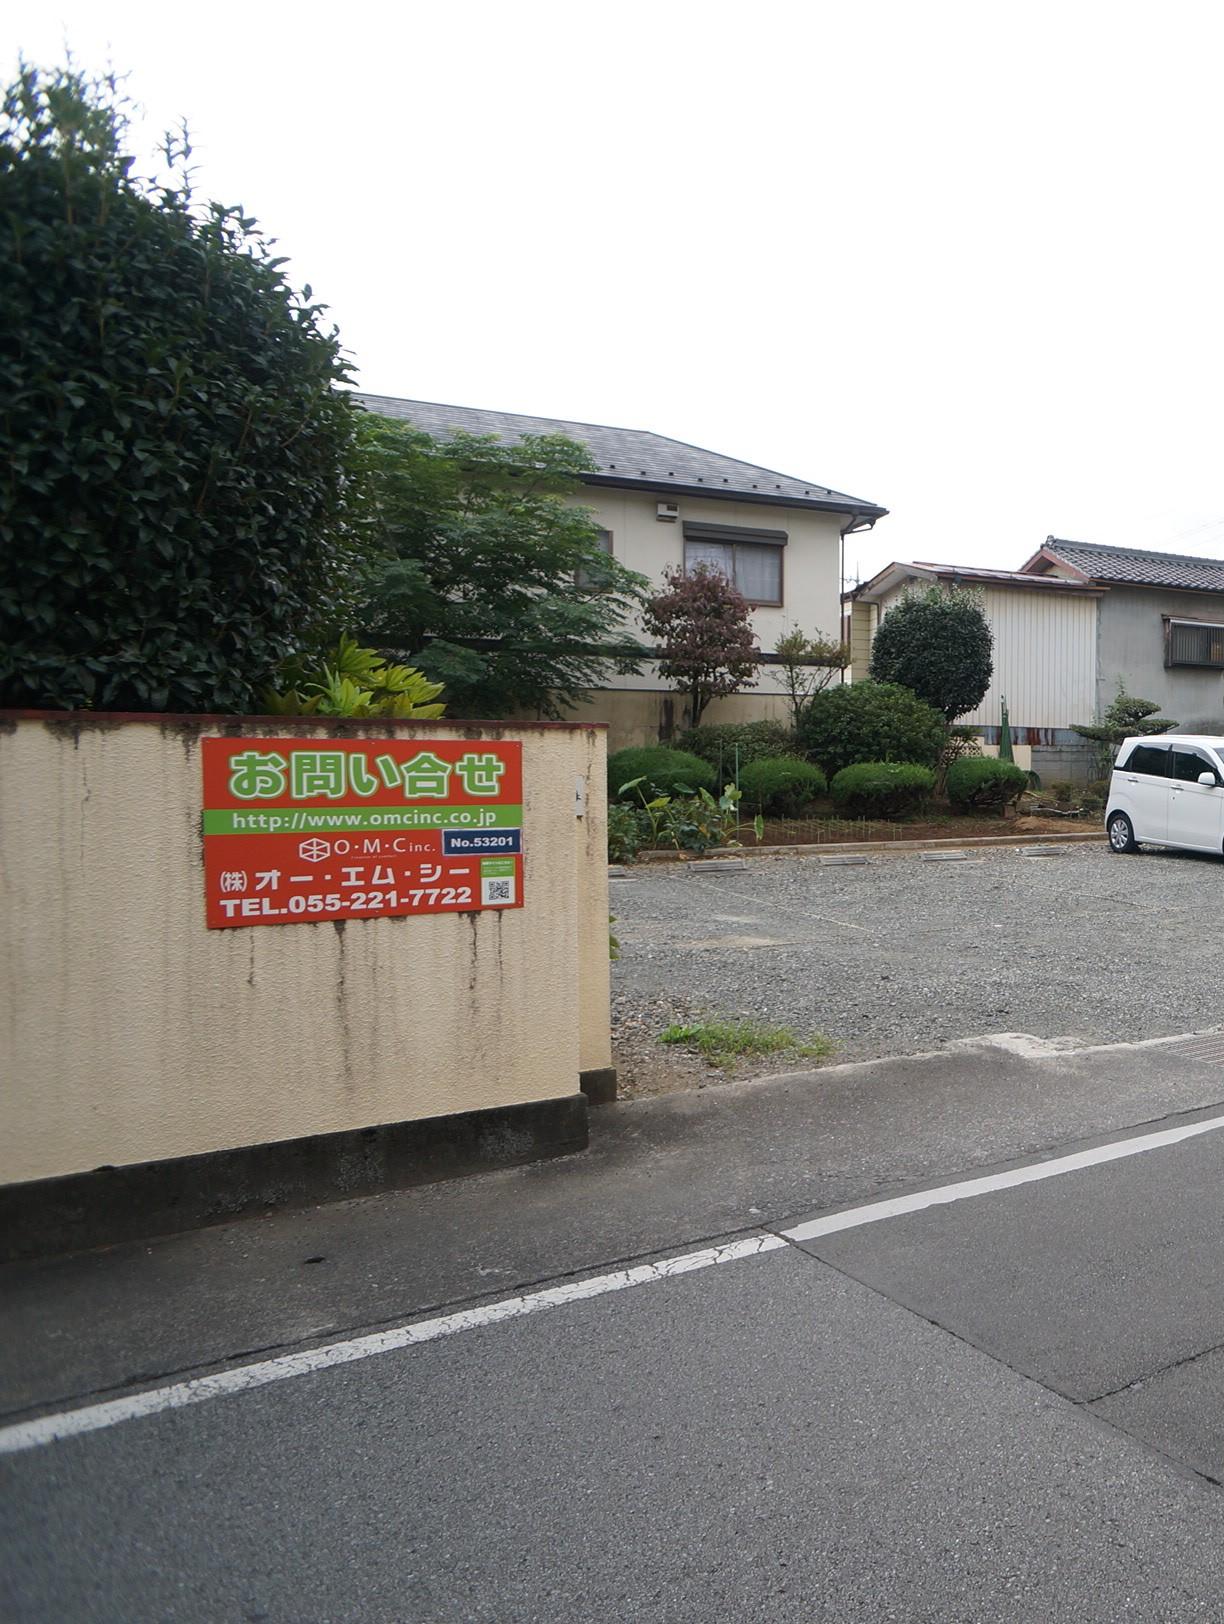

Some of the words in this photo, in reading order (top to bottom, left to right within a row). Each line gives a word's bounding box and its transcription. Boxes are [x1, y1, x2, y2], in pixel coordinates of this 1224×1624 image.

[230, 751, 504, 798] お問い合せ
[232, 810, 496, 831] http://www.omcinc.co.jp
[450, 836, 514, 849] No.53201
[219, 887, 472, 918] TEL.055-221-7722
